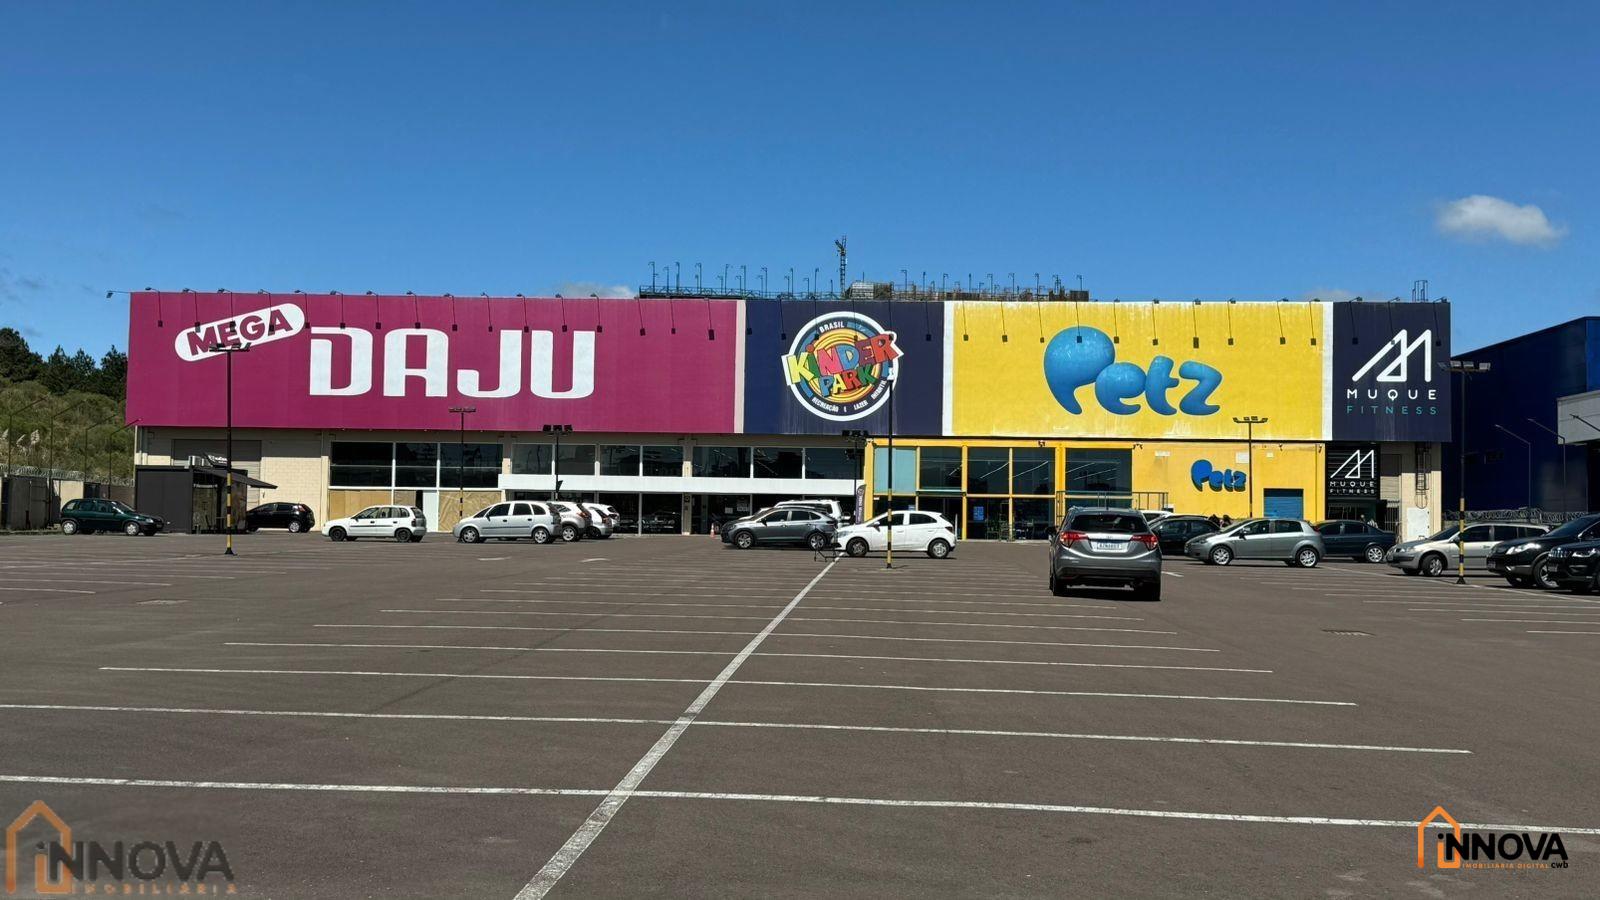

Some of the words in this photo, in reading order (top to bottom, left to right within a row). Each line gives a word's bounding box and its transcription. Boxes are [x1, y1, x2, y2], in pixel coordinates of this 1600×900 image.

[187, 309, 294, 357] MEGA
[819, 321, 845, 334] BRASIL
[310, 327, 596, 399] DAJU
[1043, 325, 1223, 416] Petz
[820, 366, 876, 397] PARK
[1346, 388, 1437, 401] MUQUE
[1347, 405, 1437, 415] FITNESS
[1190, 459, 1247, 492] Petz
